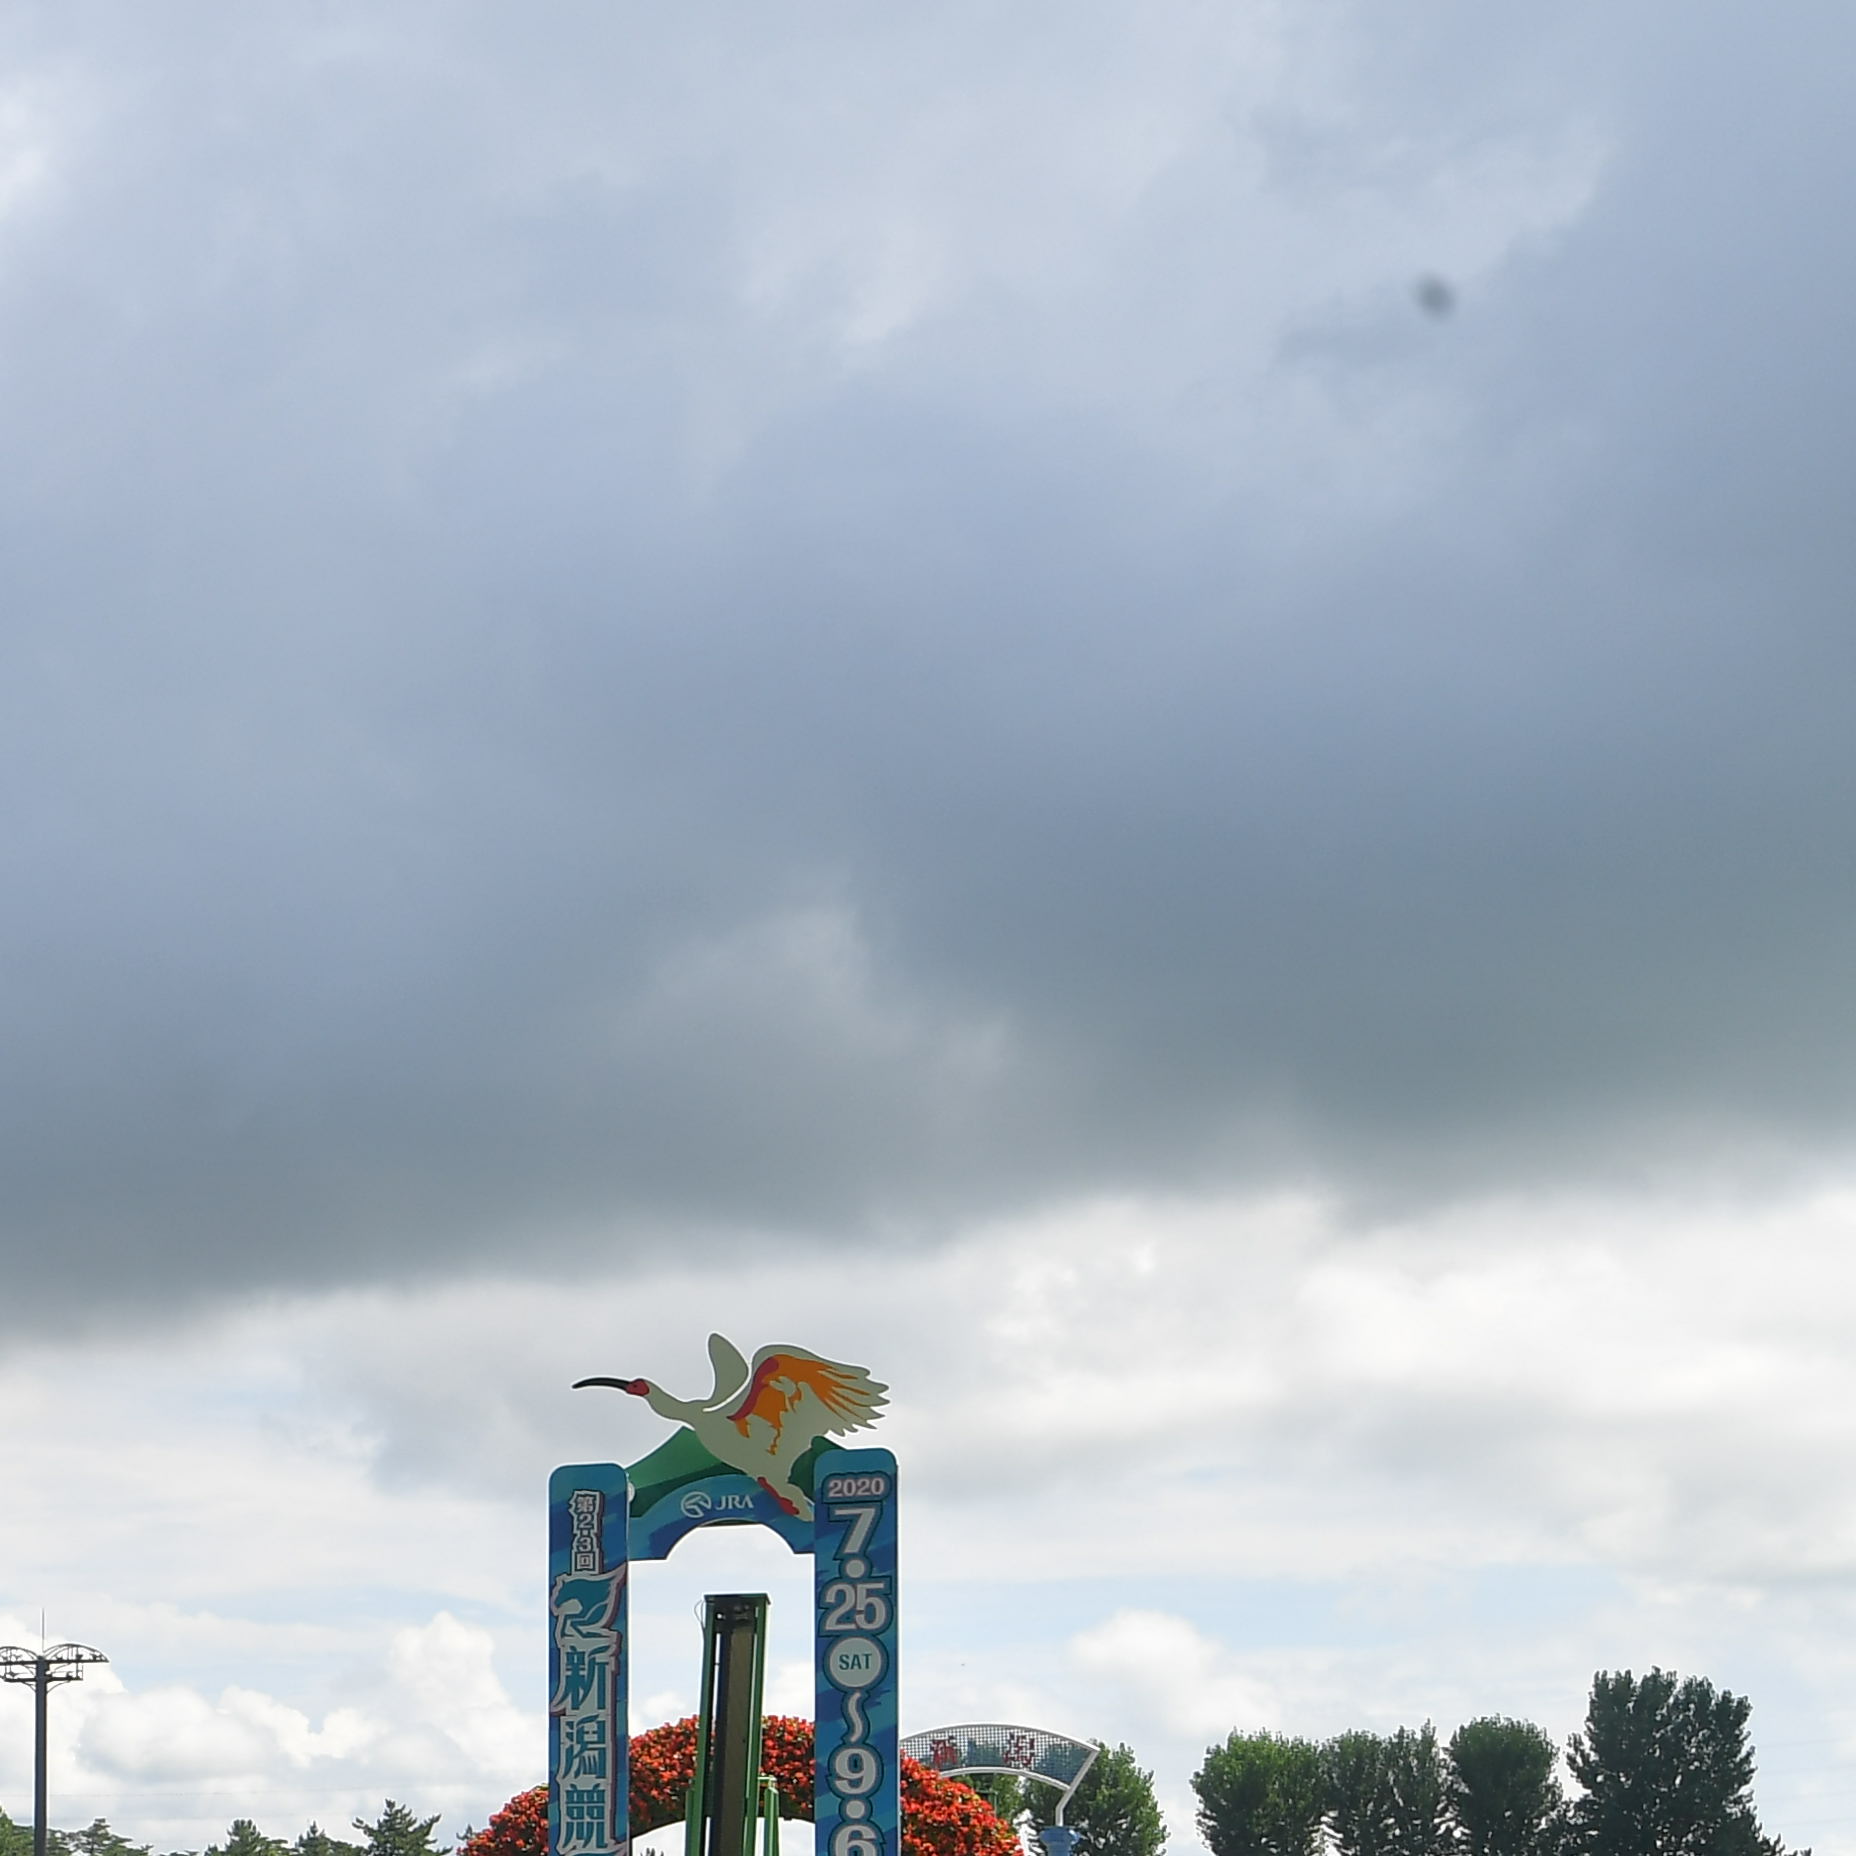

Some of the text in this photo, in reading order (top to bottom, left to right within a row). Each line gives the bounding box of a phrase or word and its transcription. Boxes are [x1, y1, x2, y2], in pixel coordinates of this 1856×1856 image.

[828, 1477, 885, 1498] 2020
[715, 1495, 754, 1510] JRA
[839, 1653, 872, 1670] SAT
